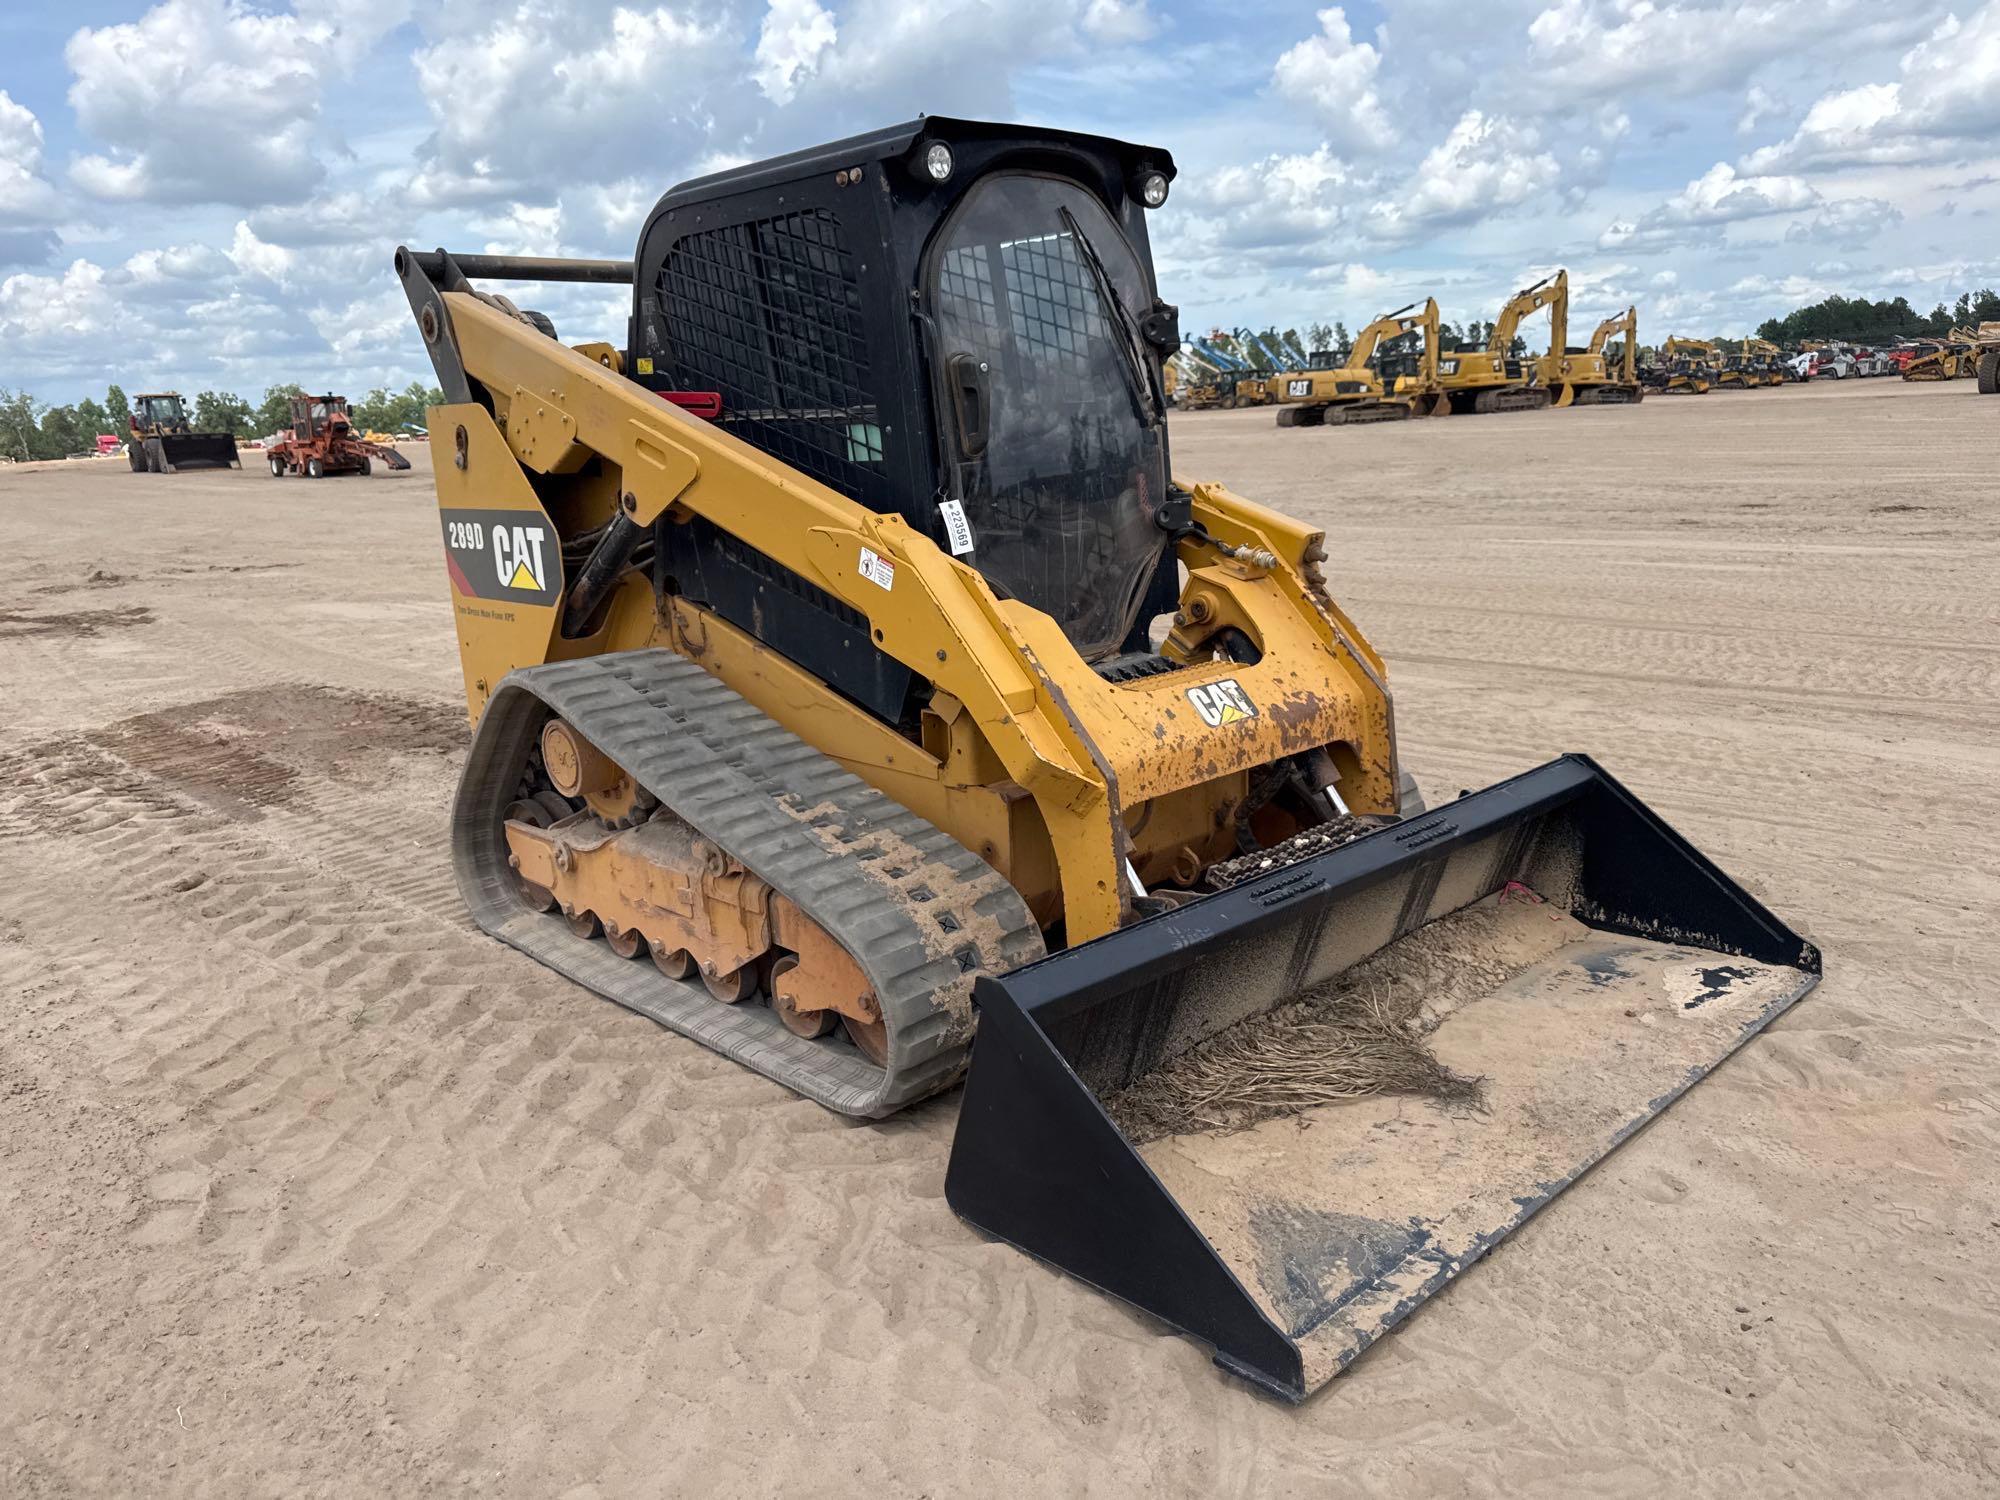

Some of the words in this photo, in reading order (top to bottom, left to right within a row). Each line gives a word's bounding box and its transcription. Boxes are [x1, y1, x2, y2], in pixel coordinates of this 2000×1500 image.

[1289, 381, 1309, 396] CAT
[449, 522, 484, 549] 289D
[950, 510, 969, 546] 223569
[492, 524, 546, 591] CAT
[1187, 679, 1255, 726] CAT
